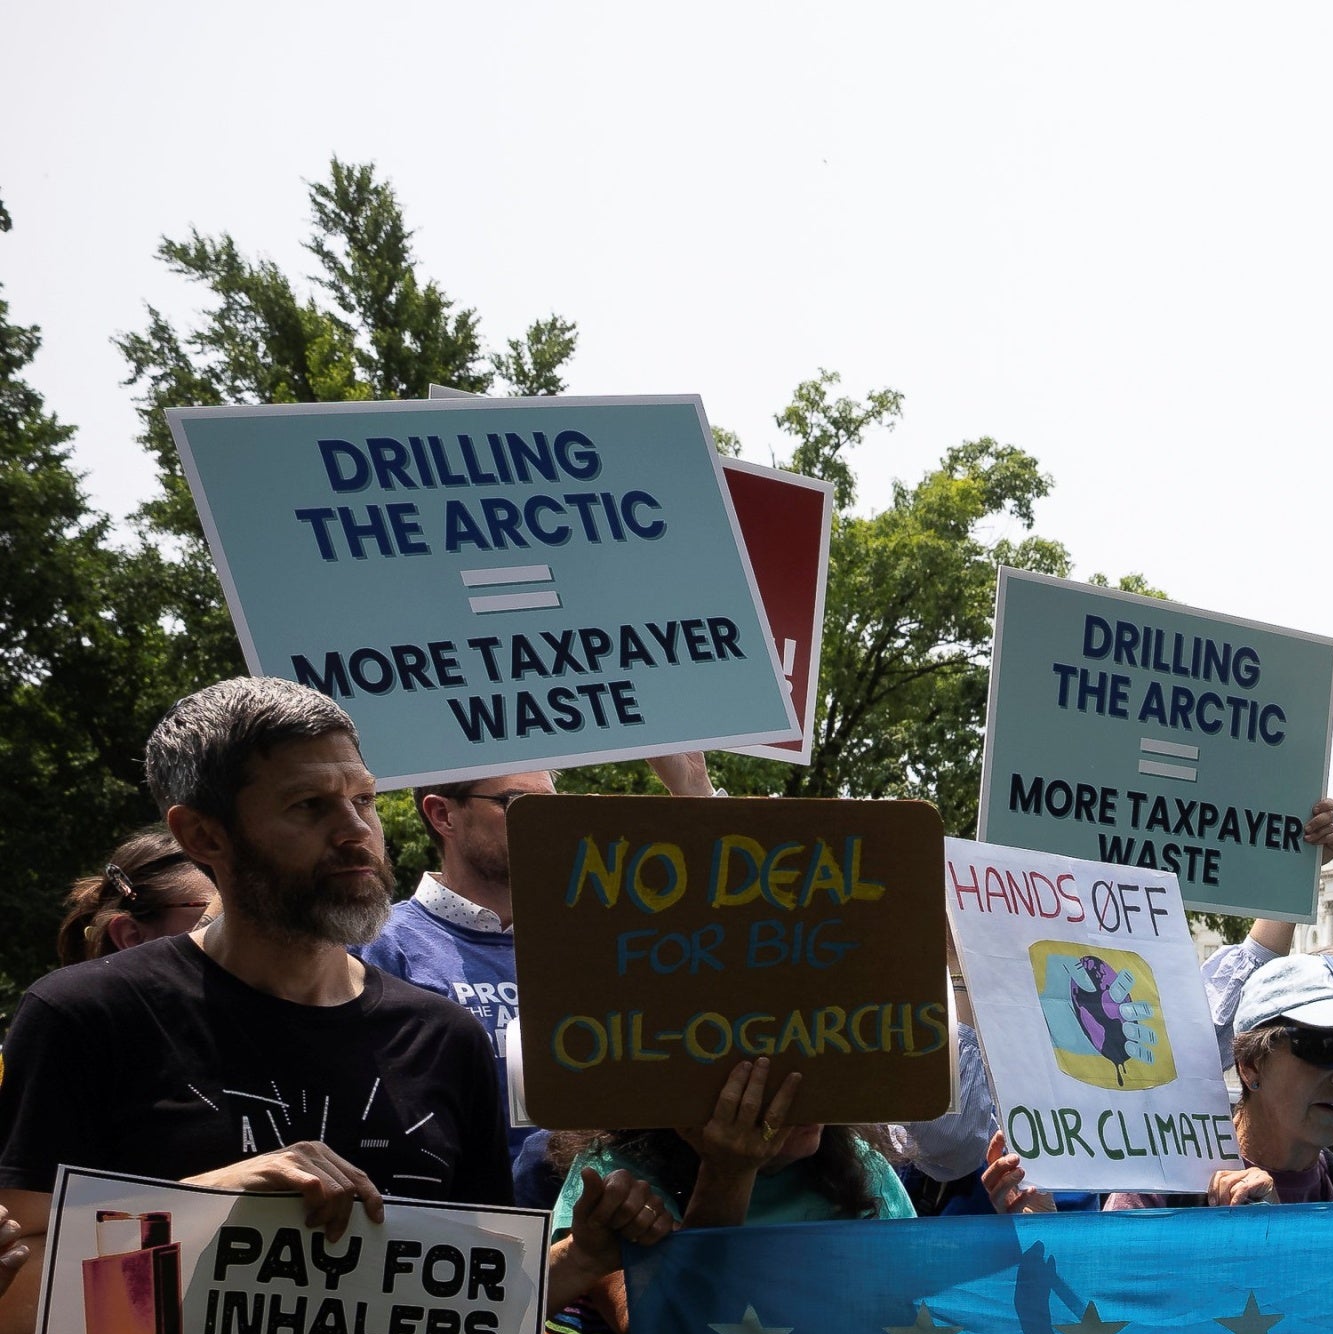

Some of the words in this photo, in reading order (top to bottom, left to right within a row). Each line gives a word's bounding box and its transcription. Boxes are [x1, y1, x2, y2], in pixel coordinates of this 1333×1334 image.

[317, 429, 602, 494] DRILLING
[296, 505, 429, 562] THE
[445, 490, 667, 552] ARCTIC
[289, 639, 464, 700] MORE
[468, 618, 745, 682] TAXPAYER
[1082, 614, 1260, 689] DRILLING
[448, 680, 645, 743] WASTE
[1052, 663, 1131, 719] THE
[1138, 681, 1287, 746] ARCTIC
[1008, 773, 1119, 826] MORE
[1127, 790, 1304, 854] TAXPAYER
[566, 834, 687, 914] NO
[707, 834, 887, 910] DEAL
[948, 861, 1085, 922] HANDS
[1099, 833, 1221, 887] WASTE
[617, 922, 725, 976] FOR
[747, 919, 859, 969] BIG
[552, 1002, 949, 1072] OIL-OGARCHS
[1008, 1105, 1096, 1159] OUR
[1098, 1109, 1240, 1161] CLIMATE
[212, 1225, 363, 1291] PAY
[382, 1239, 507, 1302] FOR
